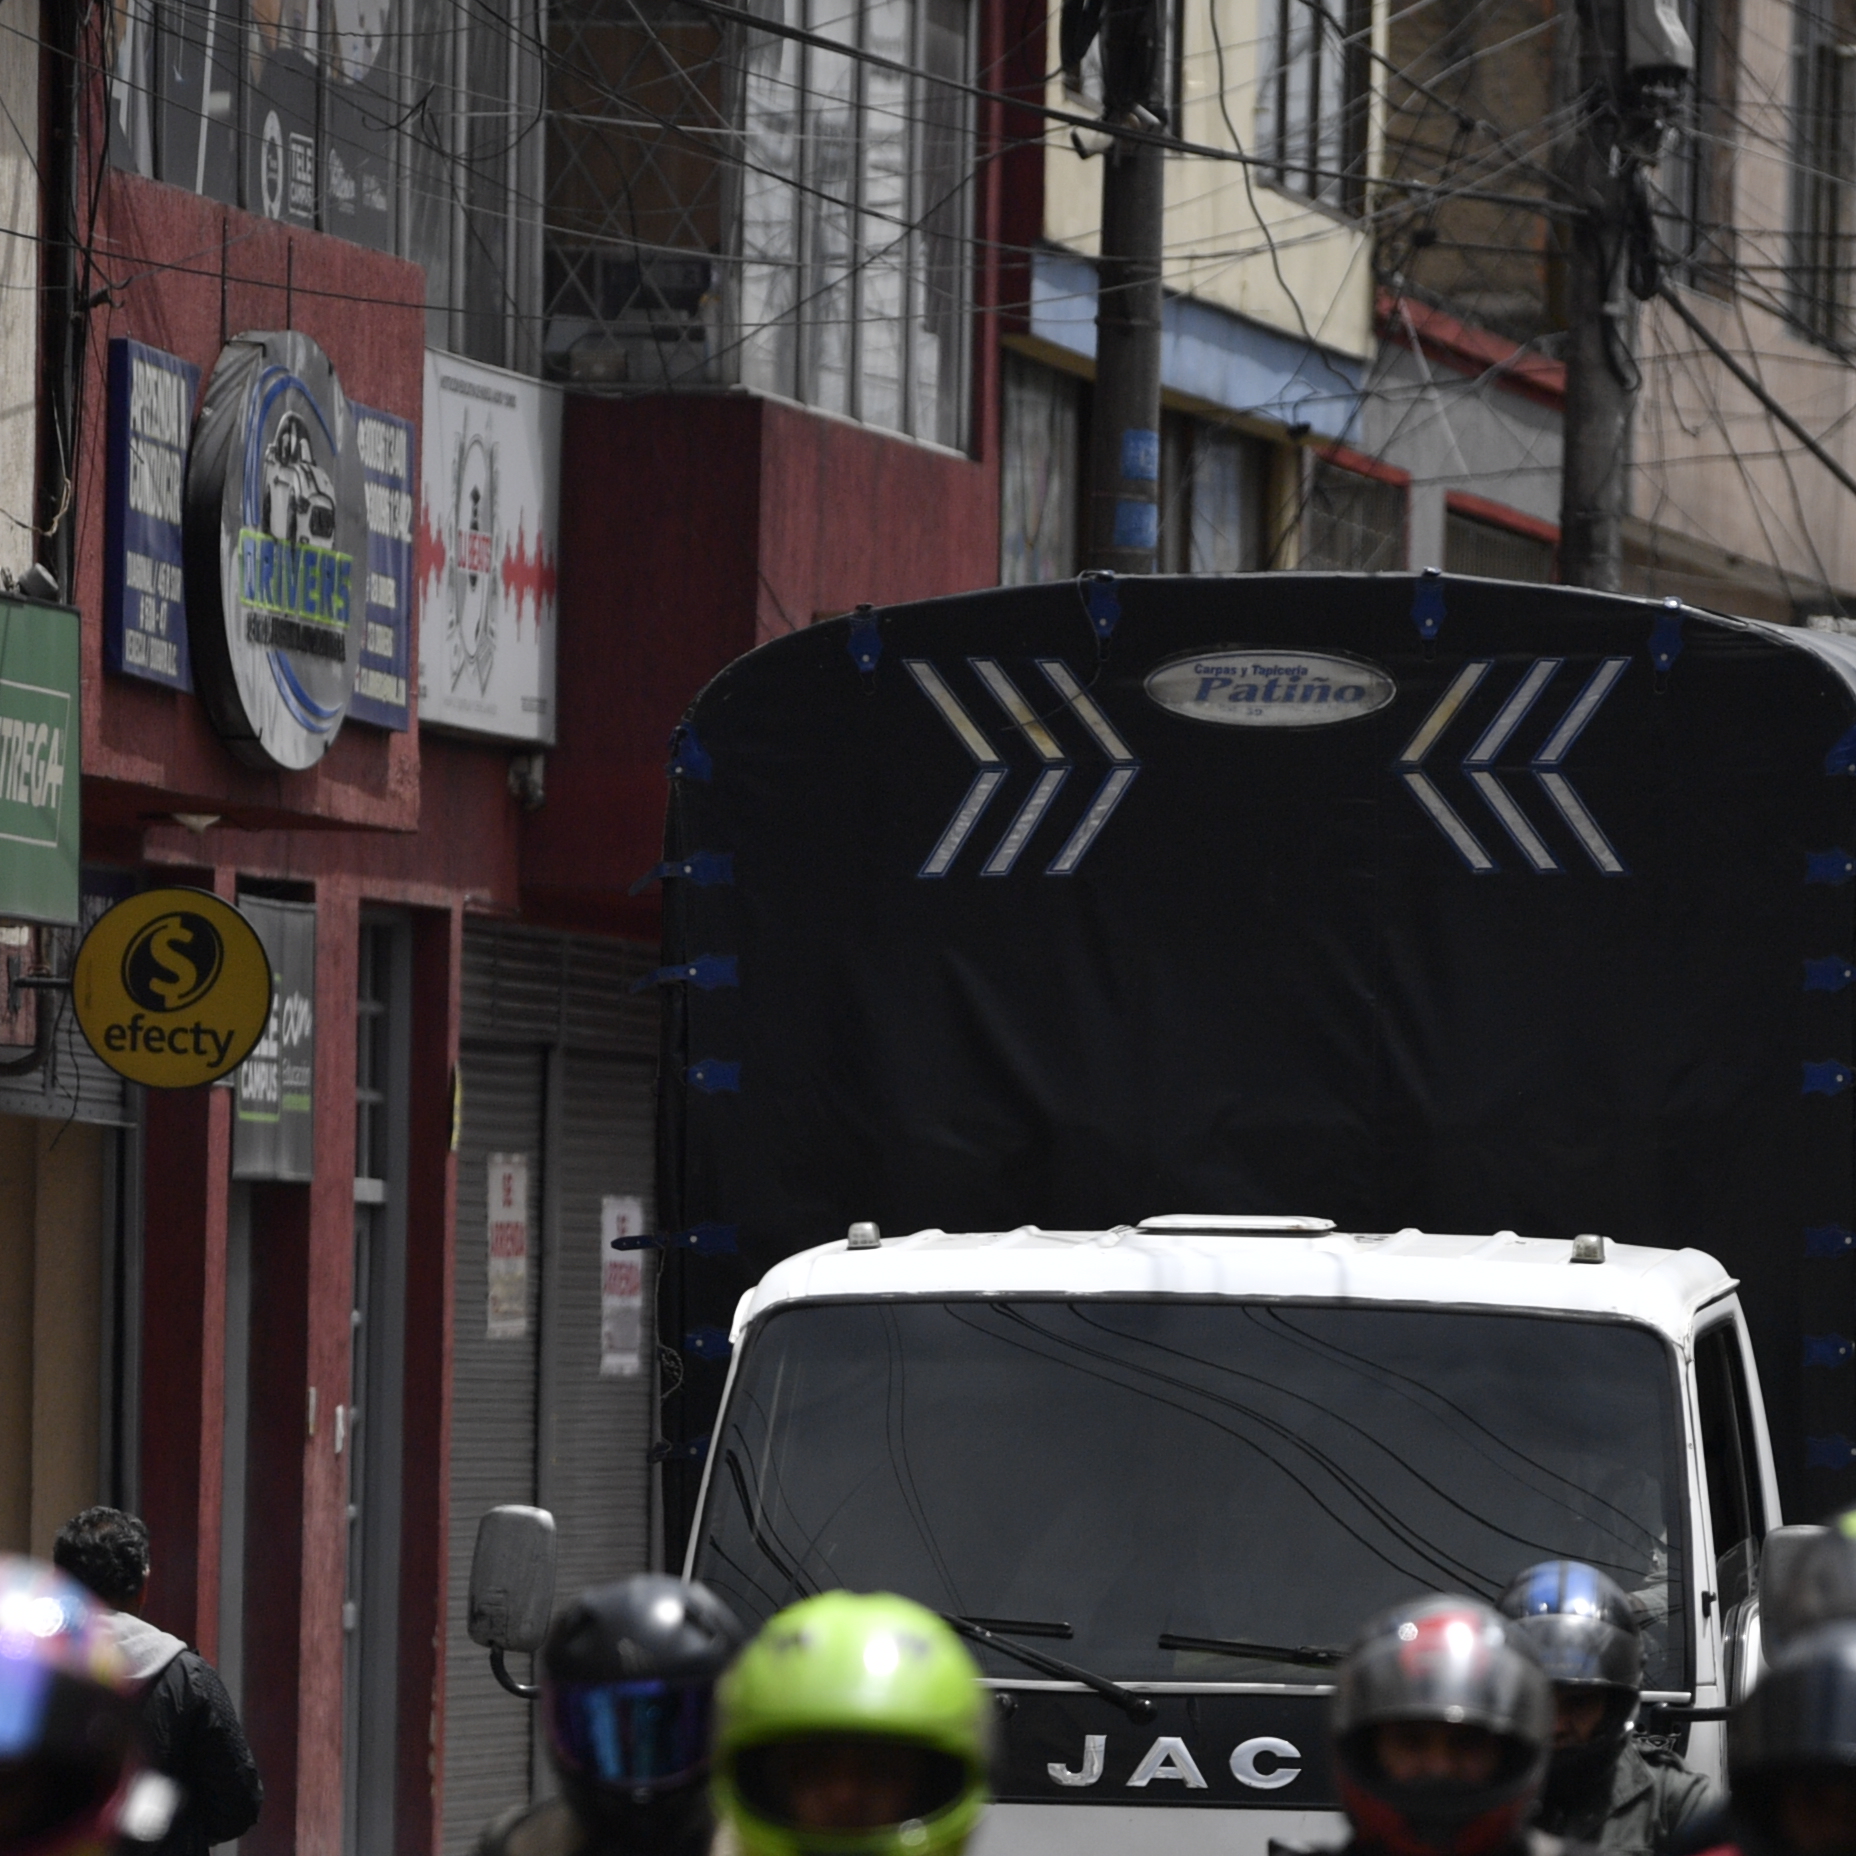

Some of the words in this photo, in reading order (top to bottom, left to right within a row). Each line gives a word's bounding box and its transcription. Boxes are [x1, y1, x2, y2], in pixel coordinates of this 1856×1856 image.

[241, 536, 352, 625] DRIVERS
[1193, 675, 1366, 704] Patiño
[1194, 663, 1237, 678] Carpas
[1240, 667, 1248, 678] y
[103, 1018, 235, 1068] efecty
[241, 1060, 278, 1102] CAMPUS
[1047, 1734, 1302, 1789] JAC
